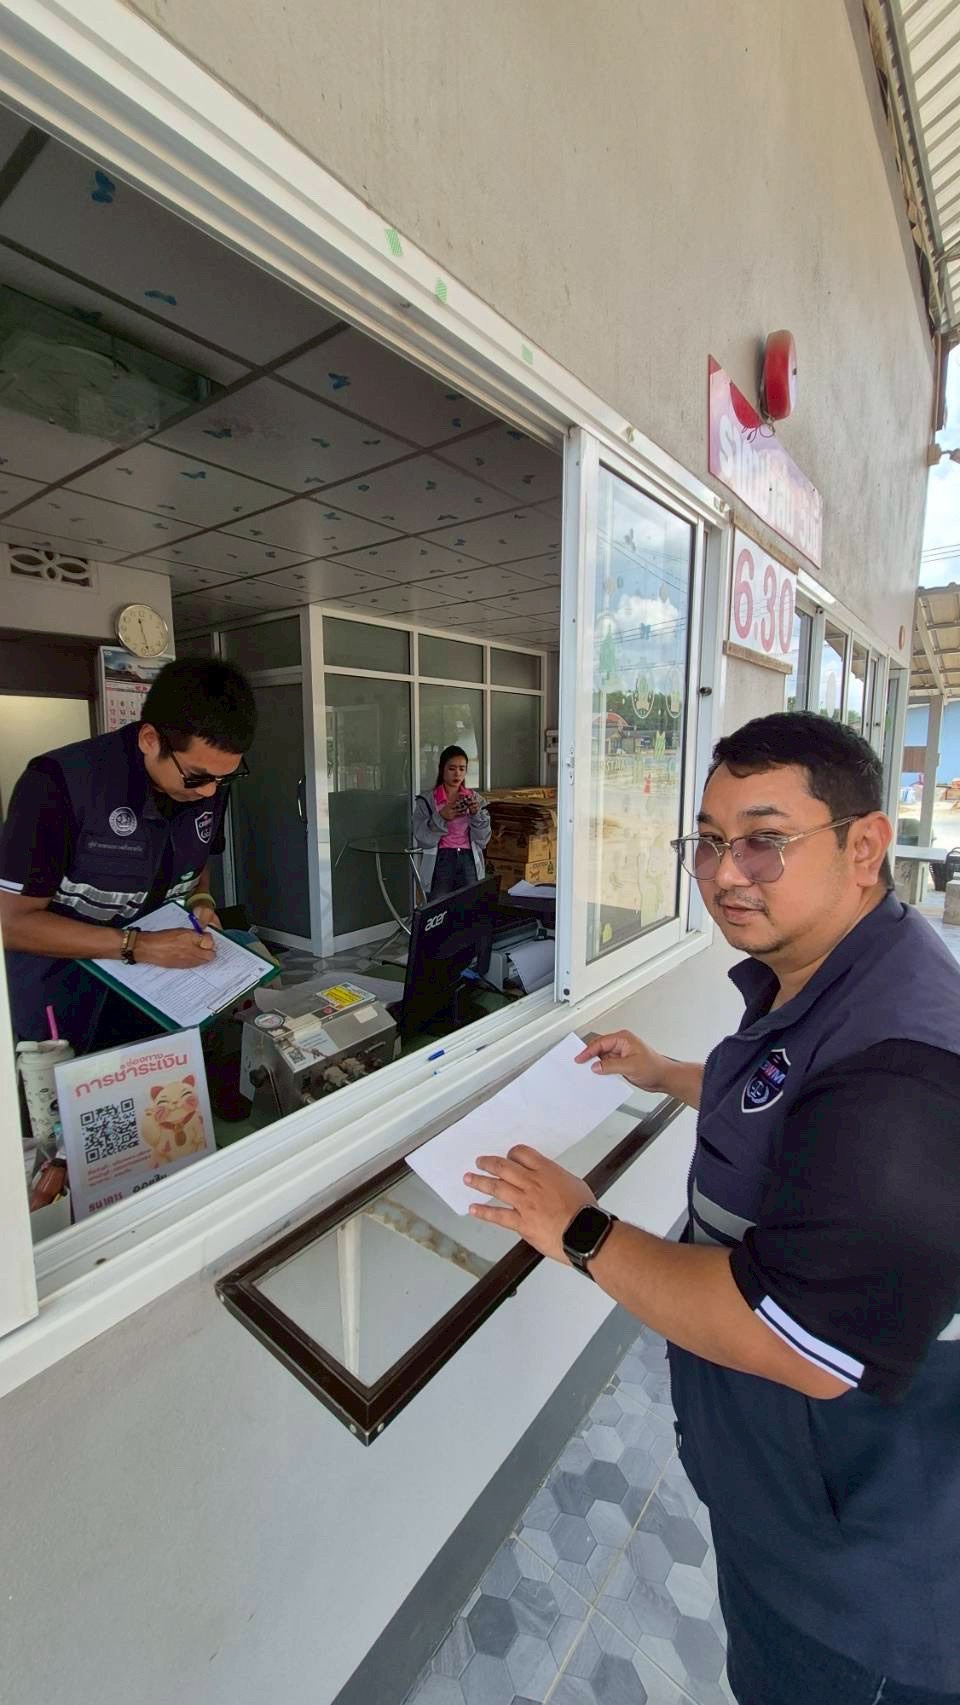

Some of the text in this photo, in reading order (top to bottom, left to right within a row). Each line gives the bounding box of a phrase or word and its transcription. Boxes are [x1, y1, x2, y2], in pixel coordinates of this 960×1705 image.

[734, 548, 794, 654] 6.30
[425, 911, 448, 931] acer
[75, 1053, 188, 1097] การชำระเงิน
[88, 1191, 123, 1212] ธนาคาร
